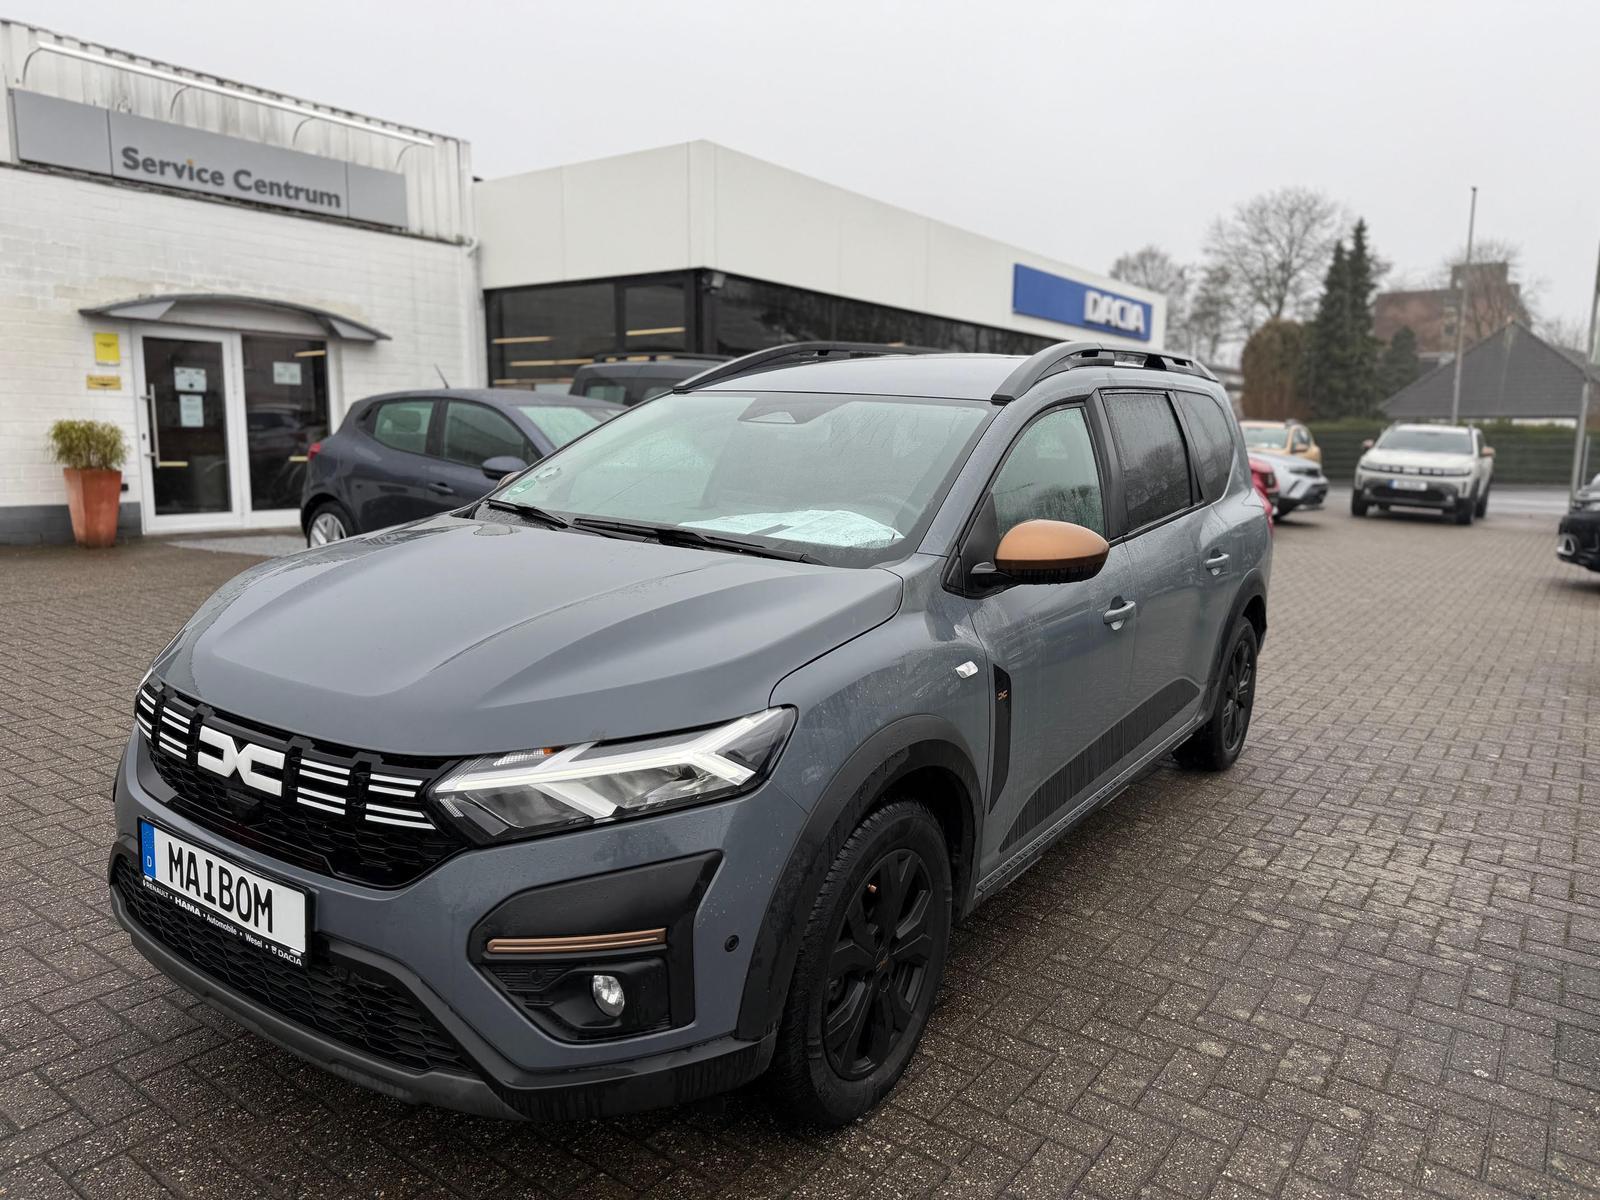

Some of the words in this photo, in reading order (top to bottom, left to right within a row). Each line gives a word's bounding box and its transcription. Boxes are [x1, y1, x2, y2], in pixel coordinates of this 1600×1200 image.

[121, 146, 225, 186] Service
[233, 169, 341, 208] Centrum
[1084, 290, 1145, 334] DACIA
[146, 855, 152, 867] D
[168, 841, 273, 934] MAIBOM
[146, 881, 168, 899] RENAULT
[175, 896, 201, 917] HAMA
[206, 914, 238, 935] Automobile
[245, 932, 263, 948] Wesel
[278, 949, 303, 967] DACIA
